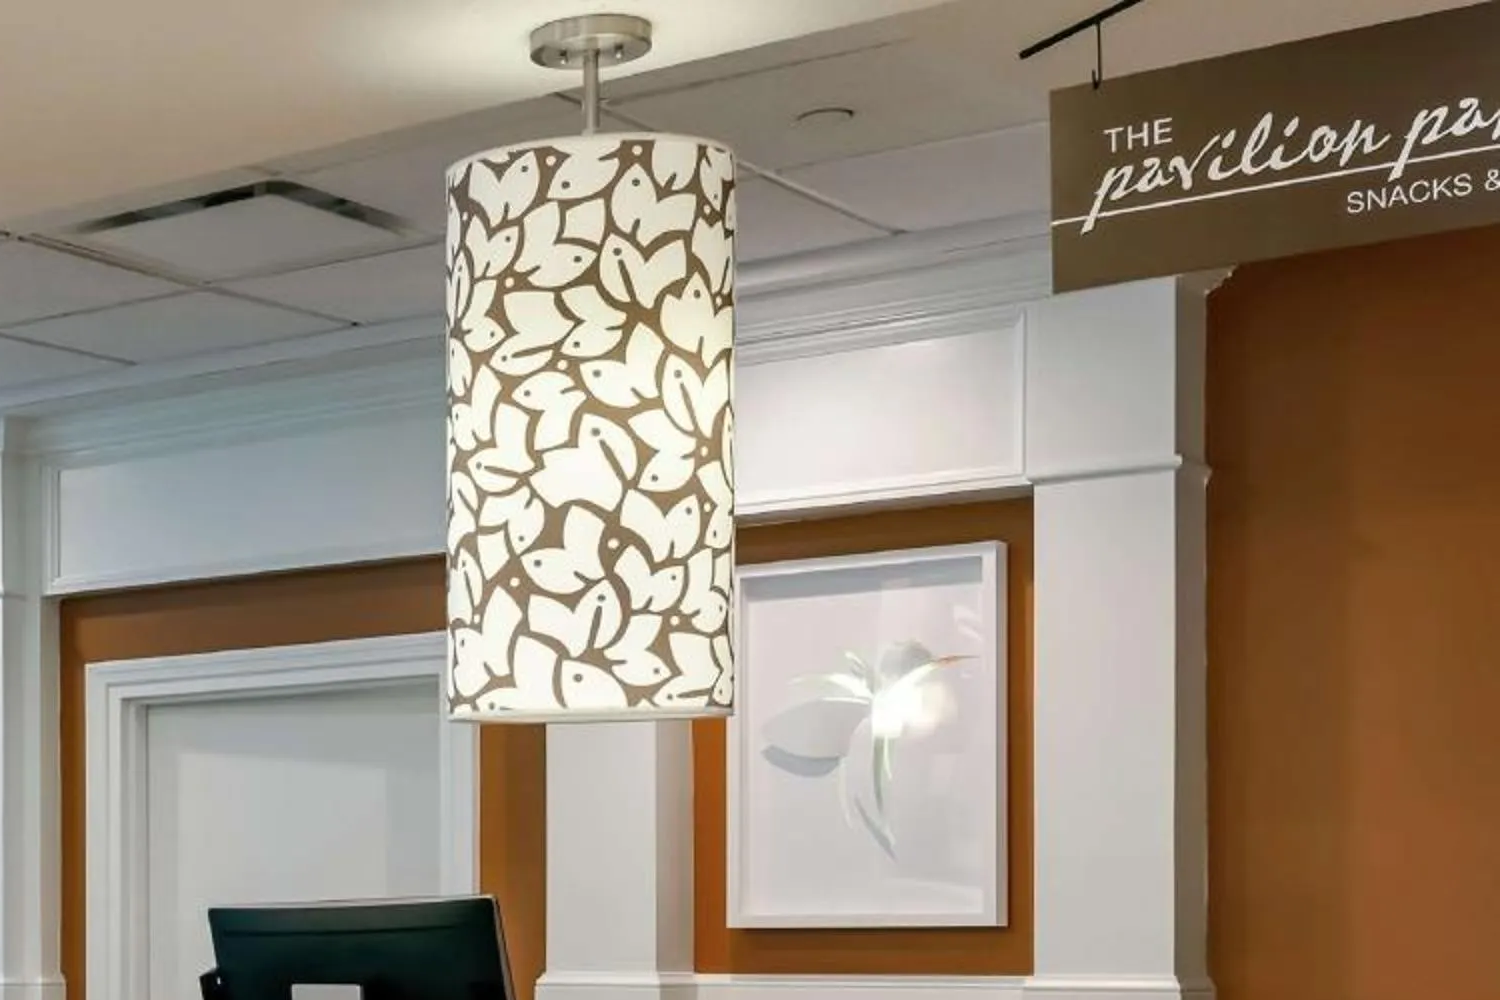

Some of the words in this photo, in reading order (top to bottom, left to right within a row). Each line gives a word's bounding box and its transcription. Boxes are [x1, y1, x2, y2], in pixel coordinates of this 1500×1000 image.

[1104, 117, 1173, 153] THE
[1080, 111, 1391, 235] pavilion
[1346, 173, 1473, 214] SNACKS
[1484, 168, 1500, 192] &
